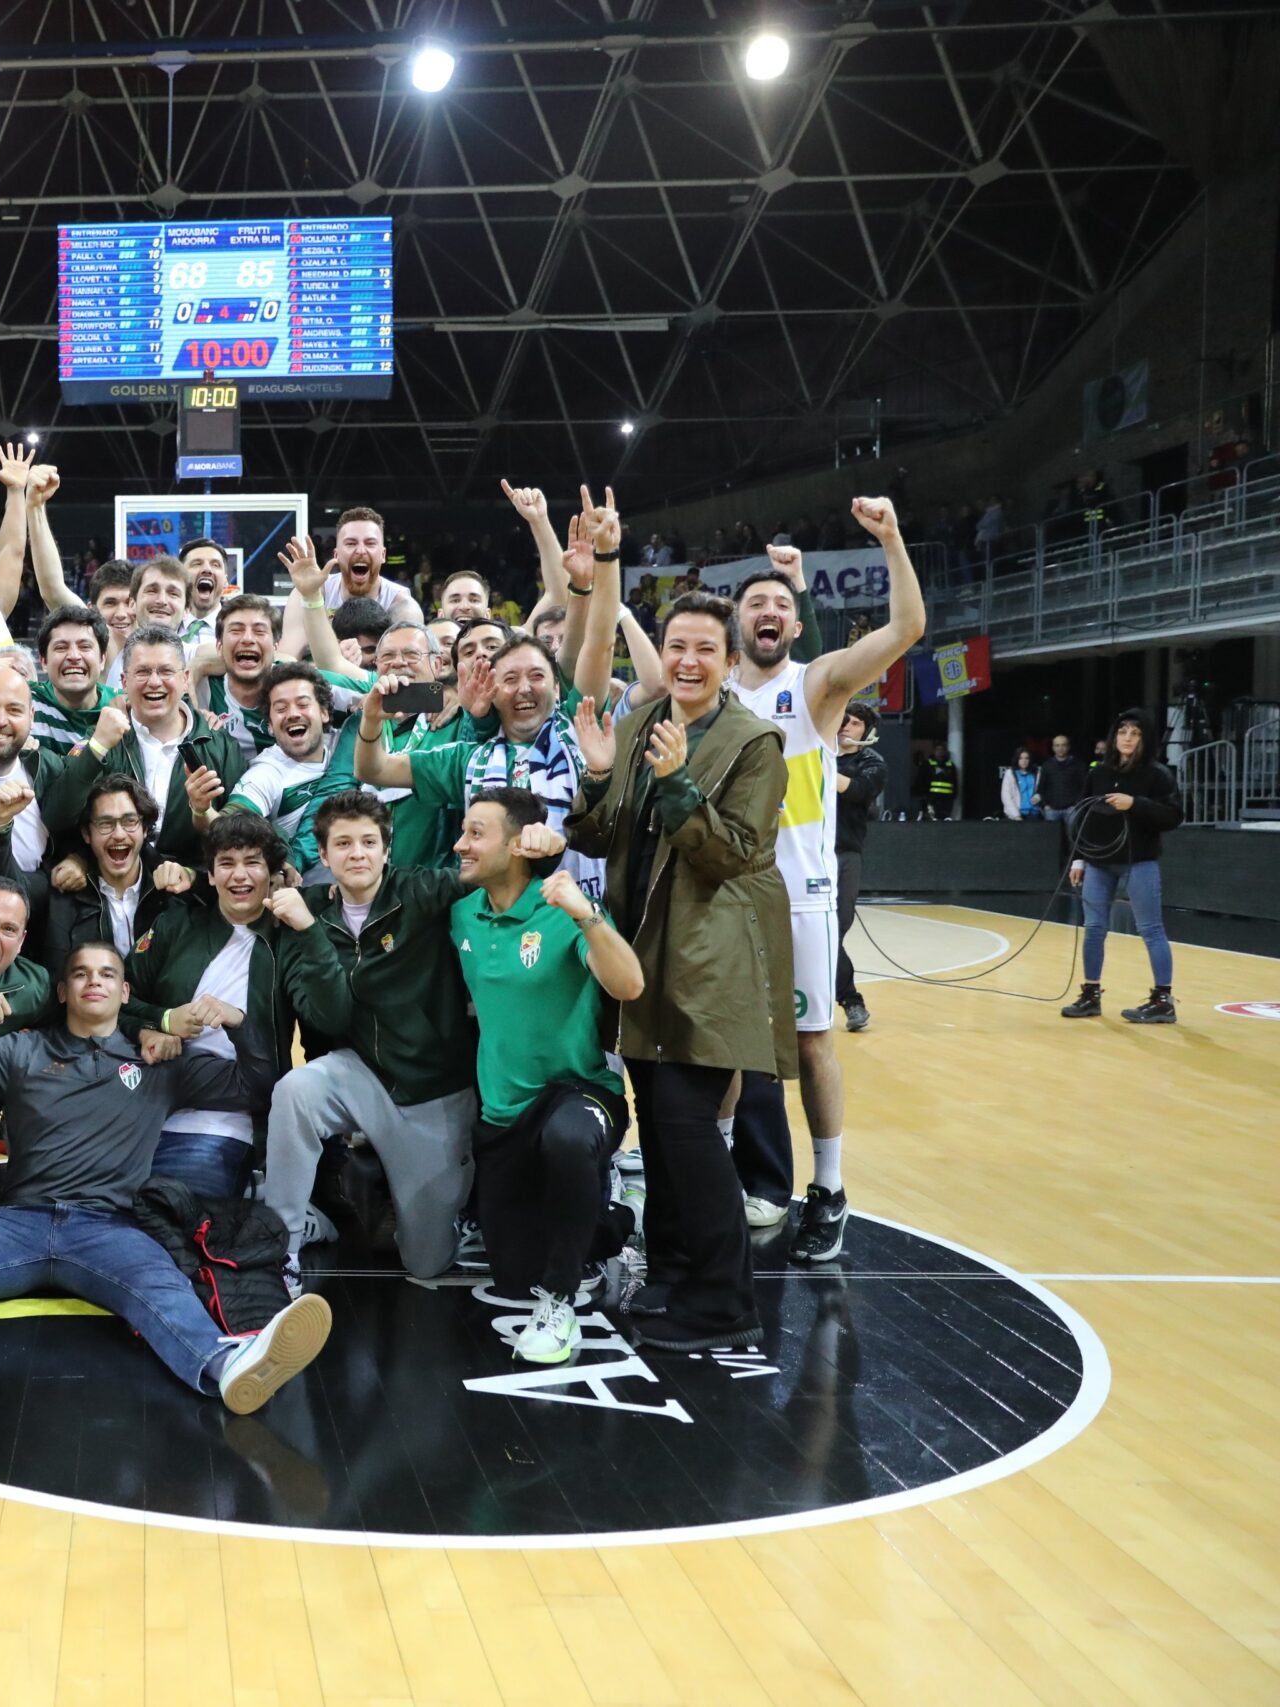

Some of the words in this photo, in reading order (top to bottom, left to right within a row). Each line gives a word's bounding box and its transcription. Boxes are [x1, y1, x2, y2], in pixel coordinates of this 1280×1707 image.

[168, 228, 219, 236] MORABANC
[238, 227, 270, 235] FRUTTI
[172, 237, 216, 245] ANDORRA
[230, 236, 259, 244] EXTRA
[262, 235, 281, 243] BUR
[170, 262, 208, 289] 68
[237, 260, 275, 288] 85
[153, 307, 160, 317] 2
[176, 303, 193, 321] 0
[219, 305, 230, 319] 4
[262, 301, 279, 319] 0
[149, 319, 160, 328] 11
[149, 342, 160, 352] 11
[380, 338, 391, 347] 11
[186, 340, 270, 368] 10:00
[380, 362, 392, 371] 12
[111, 385, 167, 396] GOLDEN
[191, 387, 238, 407] 10:00
[194, 463, 237, 471] MORABANC
